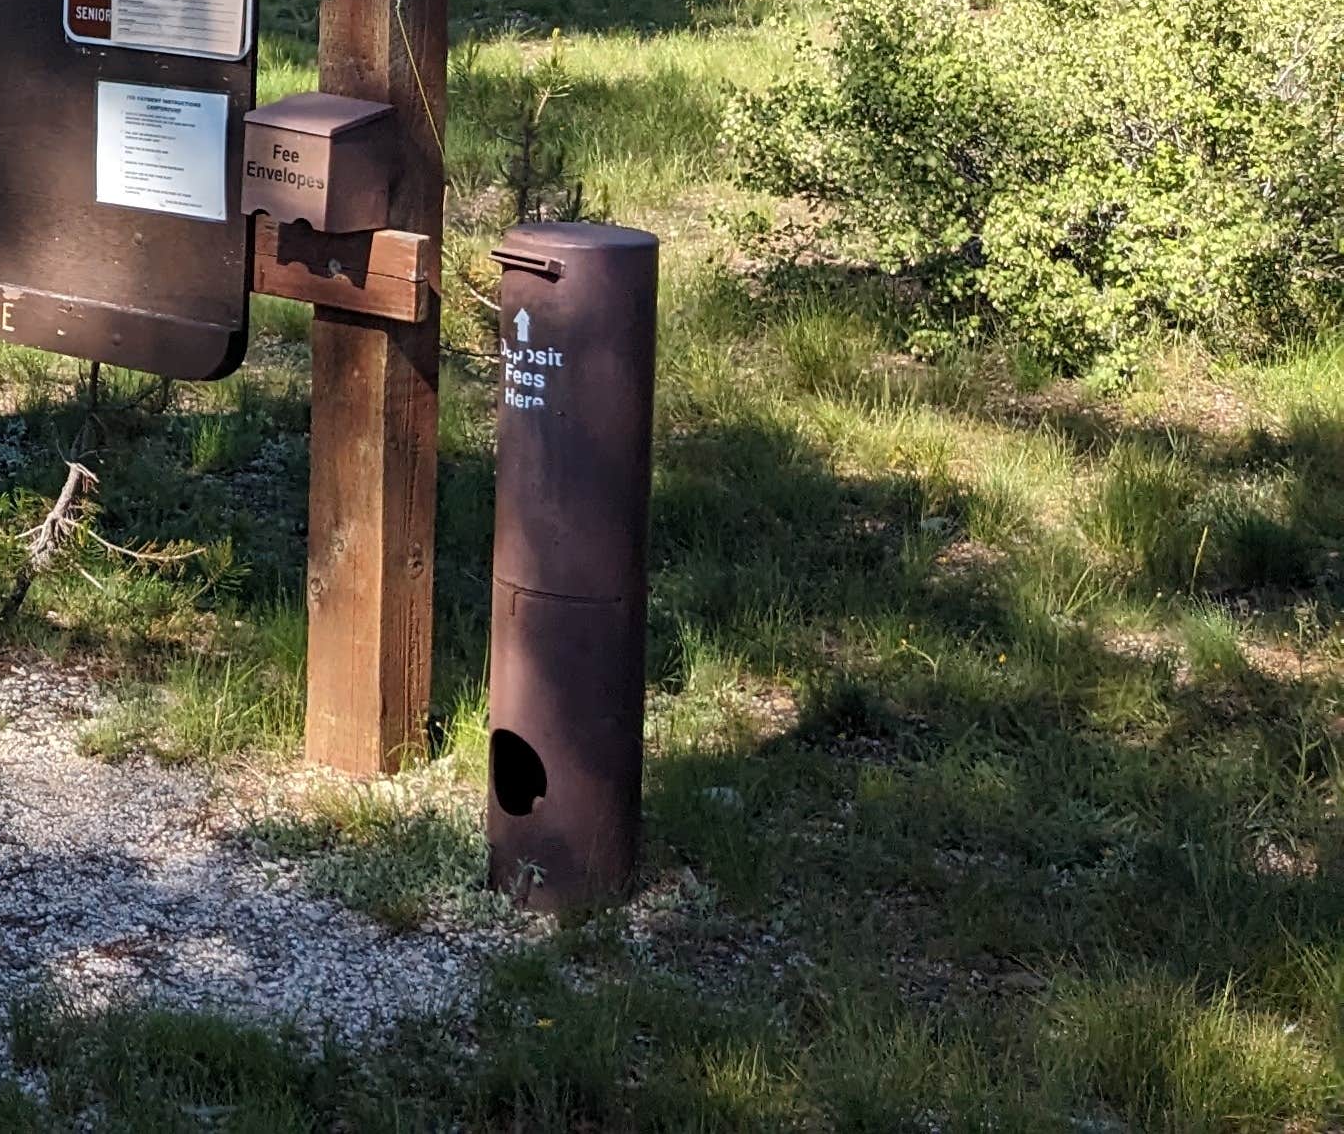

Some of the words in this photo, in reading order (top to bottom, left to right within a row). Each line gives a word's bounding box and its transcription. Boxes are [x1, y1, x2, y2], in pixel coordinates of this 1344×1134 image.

[272, 144, 300, 163] Fee
[246, 161, 325, 190] Envelopes
[505, 362, 545, 388] Fees
[505, 387, 545, 409] Here
